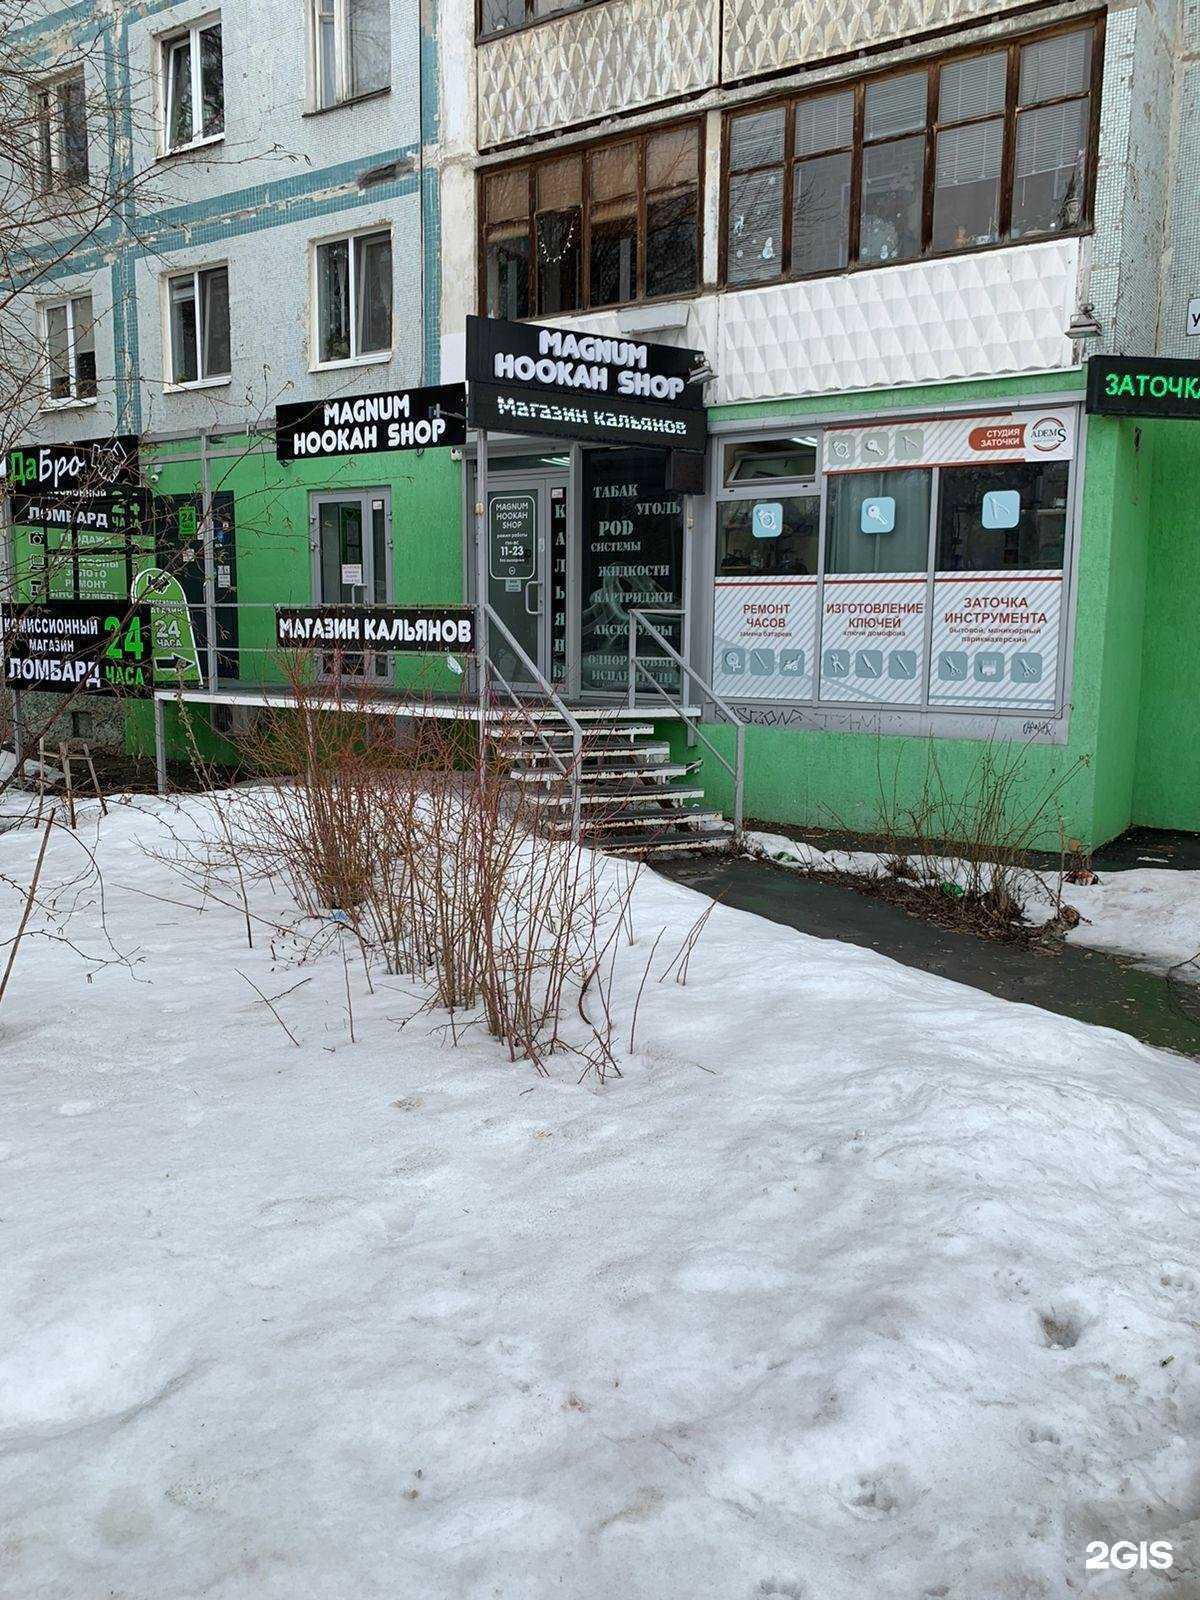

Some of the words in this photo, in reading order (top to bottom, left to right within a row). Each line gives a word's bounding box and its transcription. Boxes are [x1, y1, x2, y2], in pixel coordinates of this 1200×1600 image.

[539, 329, 648, 368] MAGNUM
[494, 352, 608, 391] HOOKAH
[617, 370, 685, 400] SHOP
[324, 394, 410, 426] MAGNUM
[497, 396, 589, 424] Магазин
[293, 425, 378, 456] HOOKAH
[387, 418, 446, 448] SHOP
[986, 428, 1020, 438] СТУДИЯ
[1031, 428, 1067, 442] ADEMS
[980, 438, 1020, 448] ЗАТОЧКИ
[11, 448, 85, 488] ДаБро
[593, 484, 638, 499] ТАБАК
[496, 502, 529, 511] MAGNUM
[636, 501, 681, 515] УГОЛЬ
[496, 512, 528, 520] HOOKAH
[502, 521, 522, 530] SHOP
[598, 520, 634, 536] POD
[501, 545, 524, 556] 11-23
[590, 541, 641, 553] СИСТЕМЫ
[66, 569, 107, 578] ЗЛОТО
[598, 564, 670, 577] ЖИДКОСТИ
[743, 604, 790, 614] РЕМОНТ
[826, 603, 923, 614] ИЗГОТОВЛЕНИЕ
[963, 597, 1028, 608] ЗАТОЧКА
[746, 618, 786, 628] ЧАСОВ
[848, 616, 902, 628] КЛЮЧЕЙ
[944, 612, 1048, 624] ИНСТРУМЕНТА
[156, 619, 181, 638] 24
[279, 617, 360, 641] МАГАЗИН
[364, 618, 472, 643] КАЛЬЯНОВ
[104, 616, 143, 660] 24
[156, 639, 182, 648] ЧАСА
[29, 638, 74, 653] МАГАЗИН
[9, 657, 100, 688] ЛОМБАРД
[105, 666, 144, 686] ЧАСА
